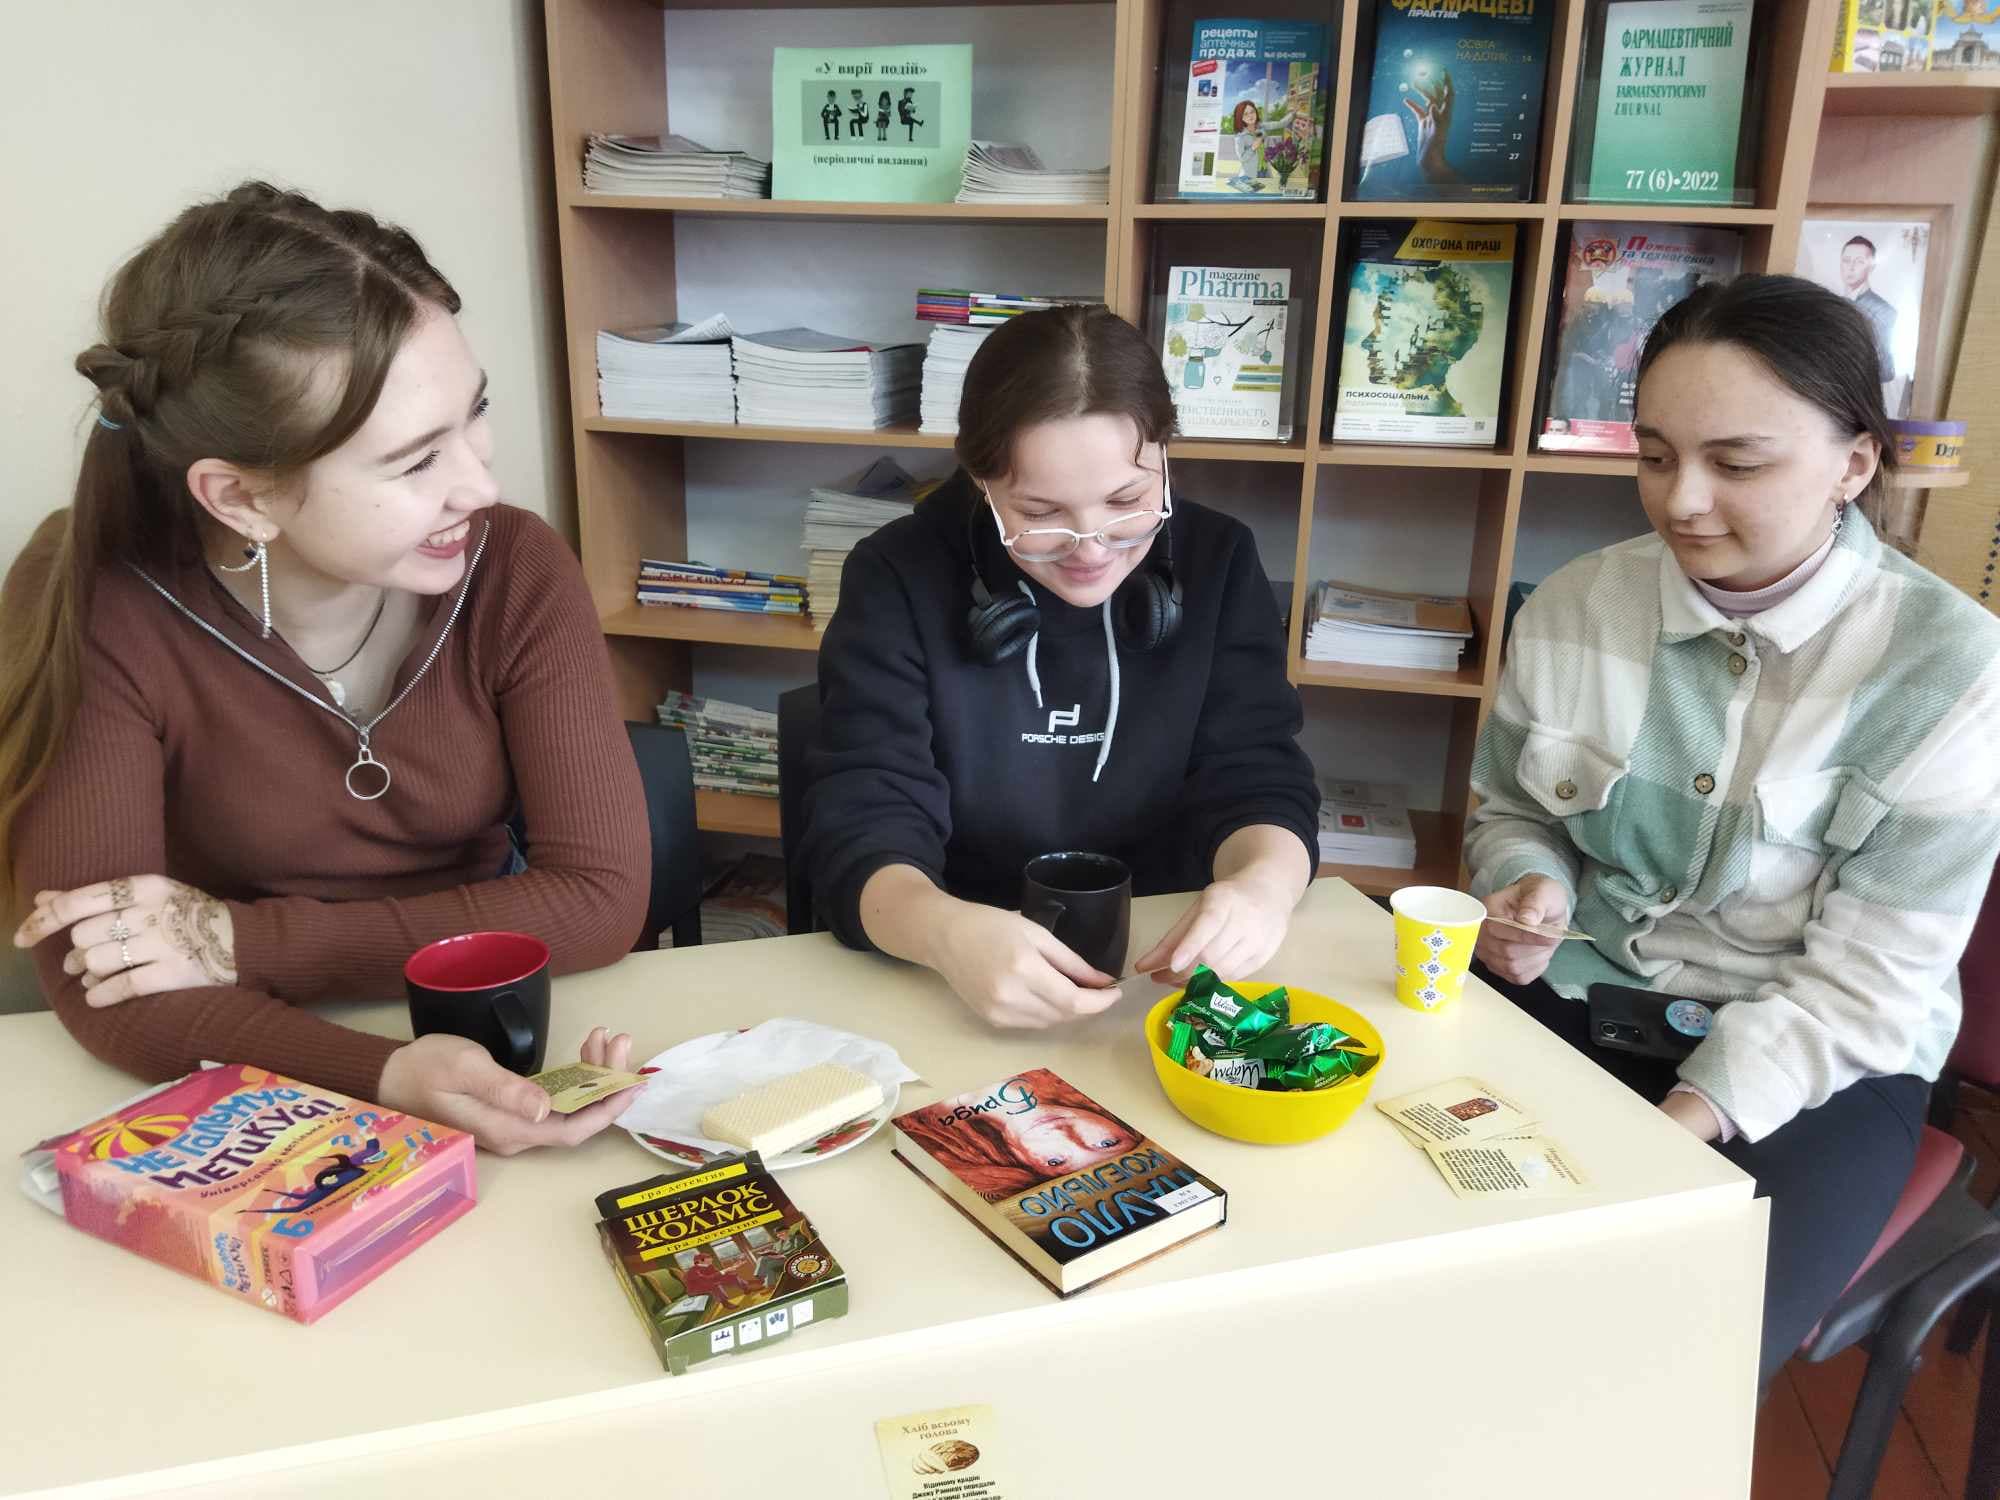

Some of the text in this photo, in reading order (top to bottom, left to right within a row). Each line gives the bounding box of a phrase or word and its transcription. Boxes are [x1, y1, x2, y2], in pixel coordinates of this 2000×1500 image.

[1407, 10, 1460, 19] ПРАКТИК
[1200, 28, 1258, 40] рецепты
[1621, 22, 1734, 49] ФАРМАЦЕВТИЧНИЙ
[1199, 40, 1257, 49] аптечных
[1199, 48, 1257, 60] продаж
[815, 61, 928, 78] «У вирії подій»
[1620, 56, 1686, 77] ЖУРНАЛ
[1614, 102, 1662, 116] ZHURNAL
[1512, 133, 1522, 141] 12
[813, 154, 928, 168] (періодичні видання)
[1625, 169, 1645, 190] 77
[1411, 236, 1502, 252] ОХОРОНА ПРАЦІ
[1178, 268, 1285, 299] Pharma
[1209, 271, 1261, 281] magazine
[1021, 732, 1105, 745] PORSCHE DESIG
[939, 1078, 1038, 1127] Брида
[107, 1150, 188, 1174] НЕ
[1020, 1148, 1169, 1217] КОЕЛЬЙО
[623, 1180, 765, 1233] ШЕРЛОК
[630, 1194, 775, 1250] ХОЛМС
[901, 1417, 972, 1436] Хліб всьому
[920, 1428, 959, 1440] голова
